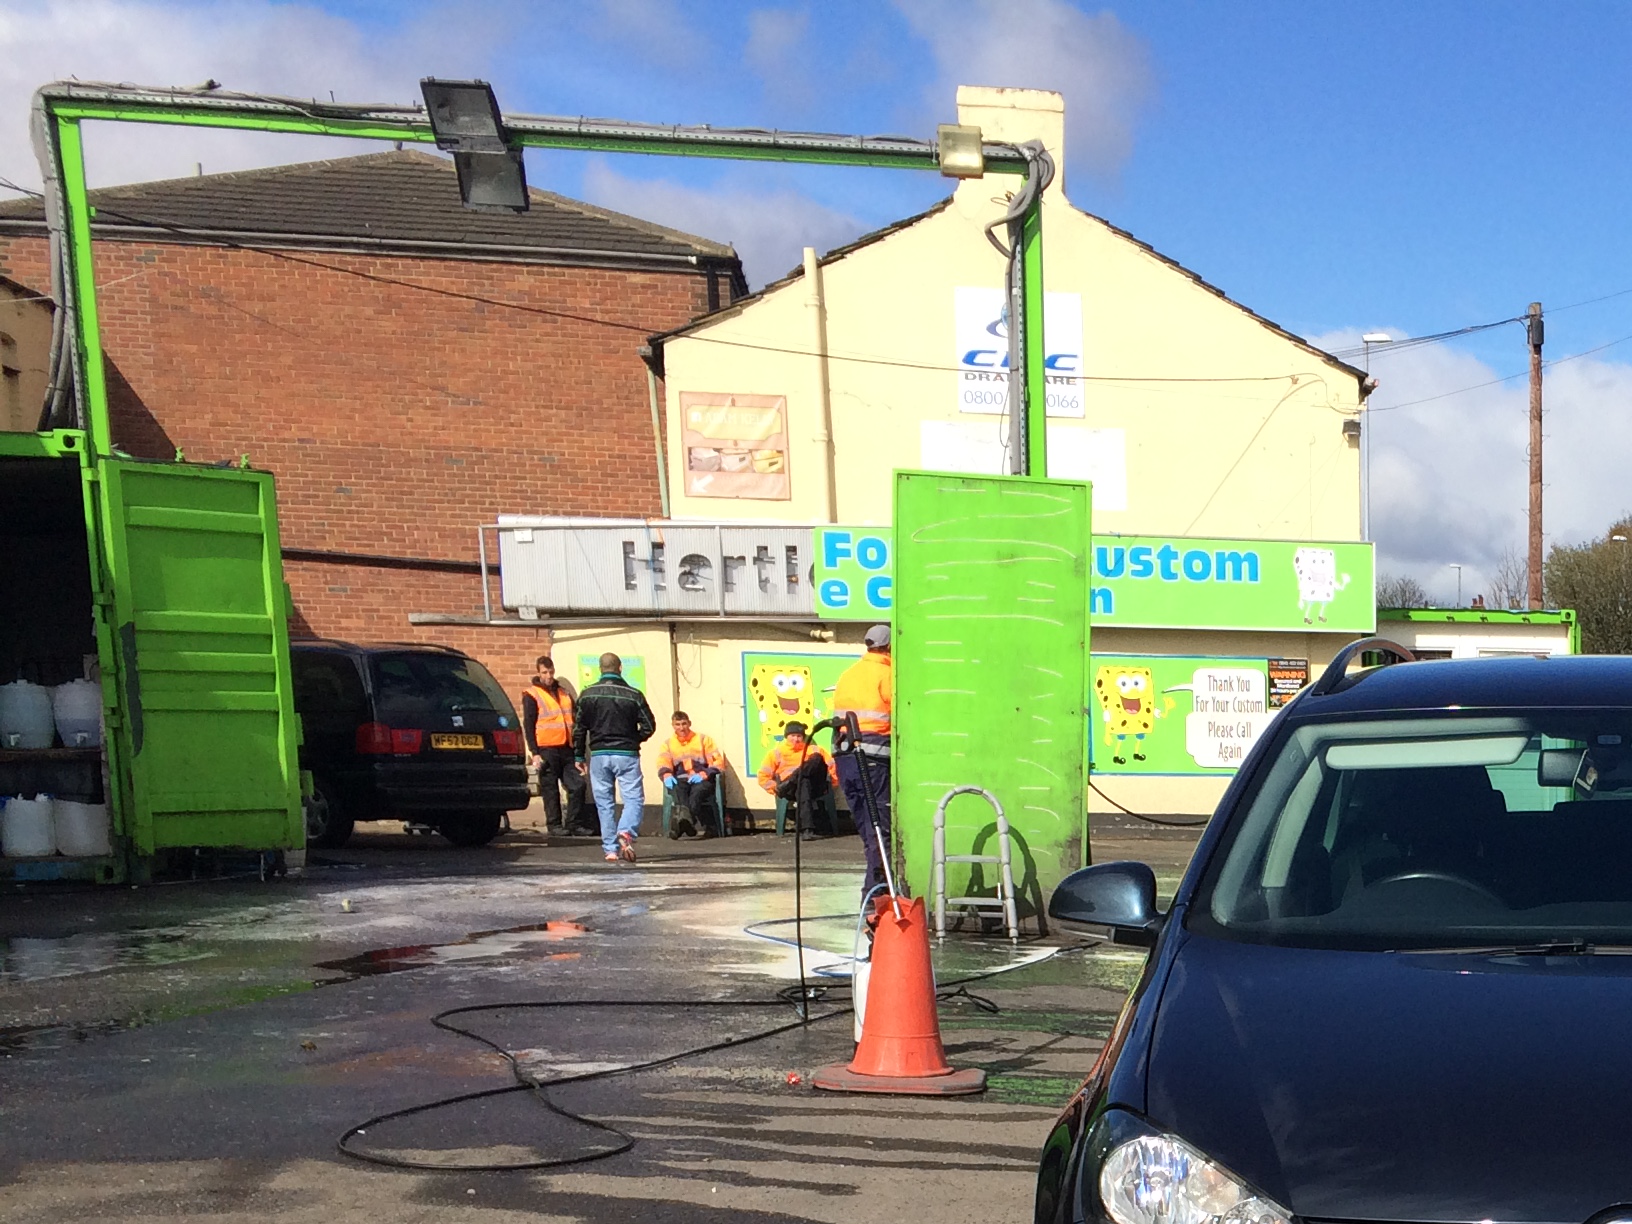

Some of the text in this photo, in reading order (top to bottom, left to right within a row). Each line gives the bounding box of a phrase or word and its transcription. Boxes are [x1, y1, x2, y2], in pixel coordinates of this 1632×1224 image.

[961, 349, 1079, 371] CC
[963, 390, 1079, 409] 0800 0166
[823, 531, 1260, 582] Fo ustom
[621, 539, 815, 596] Hartl
[1207, 675, 1251, 692] Thank You
[1195, 695, 1209, 713] For
[1211, 696, 1230, 713] Your
[1232, 696, 1263, 713] Custom
[1207, 721, 1252, 738] Please Call
[1217, 742, 1242, 762] Again
